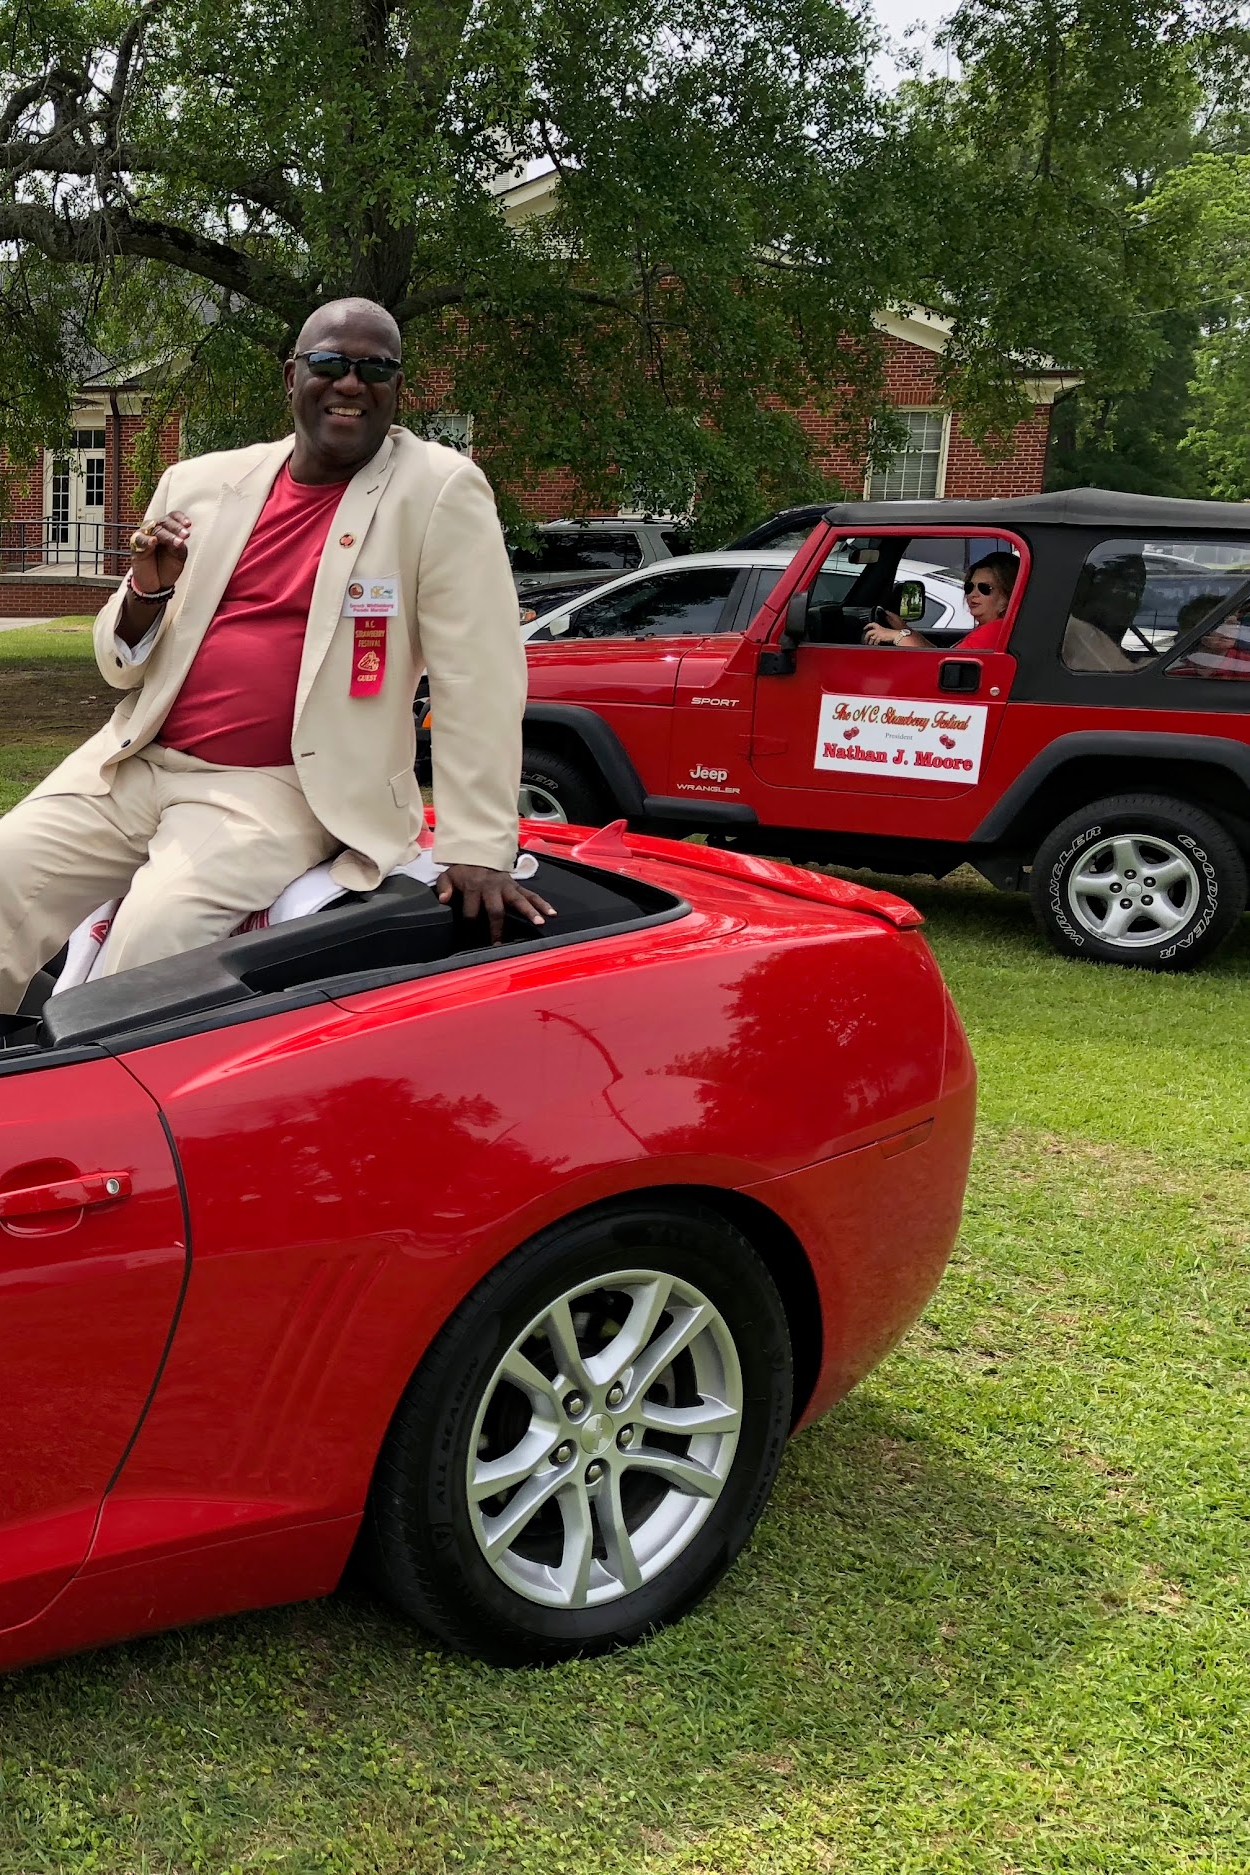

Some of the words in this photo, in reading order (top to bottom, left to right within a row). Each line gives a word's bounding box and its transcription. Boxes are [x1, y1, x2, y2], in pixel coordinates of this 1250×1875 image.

[355, 630, 385, 638] STRAWBERRY
[358, 639, 381, 648] FESTIVAL
[357, 674, 378, 682] GUEST
[691, 697, 739, 707] SPORT
[832, 703, 851, 720] The
[880, 706, 930, 732] Strawberry
[931, 710, 972, 731] Festival
[885, 732, 913, 741] President
[822, 742, 888, 763] Nathan
[892, 749, 909, 765] J.
[913, 751, 974, 771] Moore
[690, 764, 728, 782] Jeep
[677, 783, 740, 794] WRANGLER
[1049, 826, 1101, 946] WRANGLER
[1159, 834, 1218, 959] GOODYEAR
